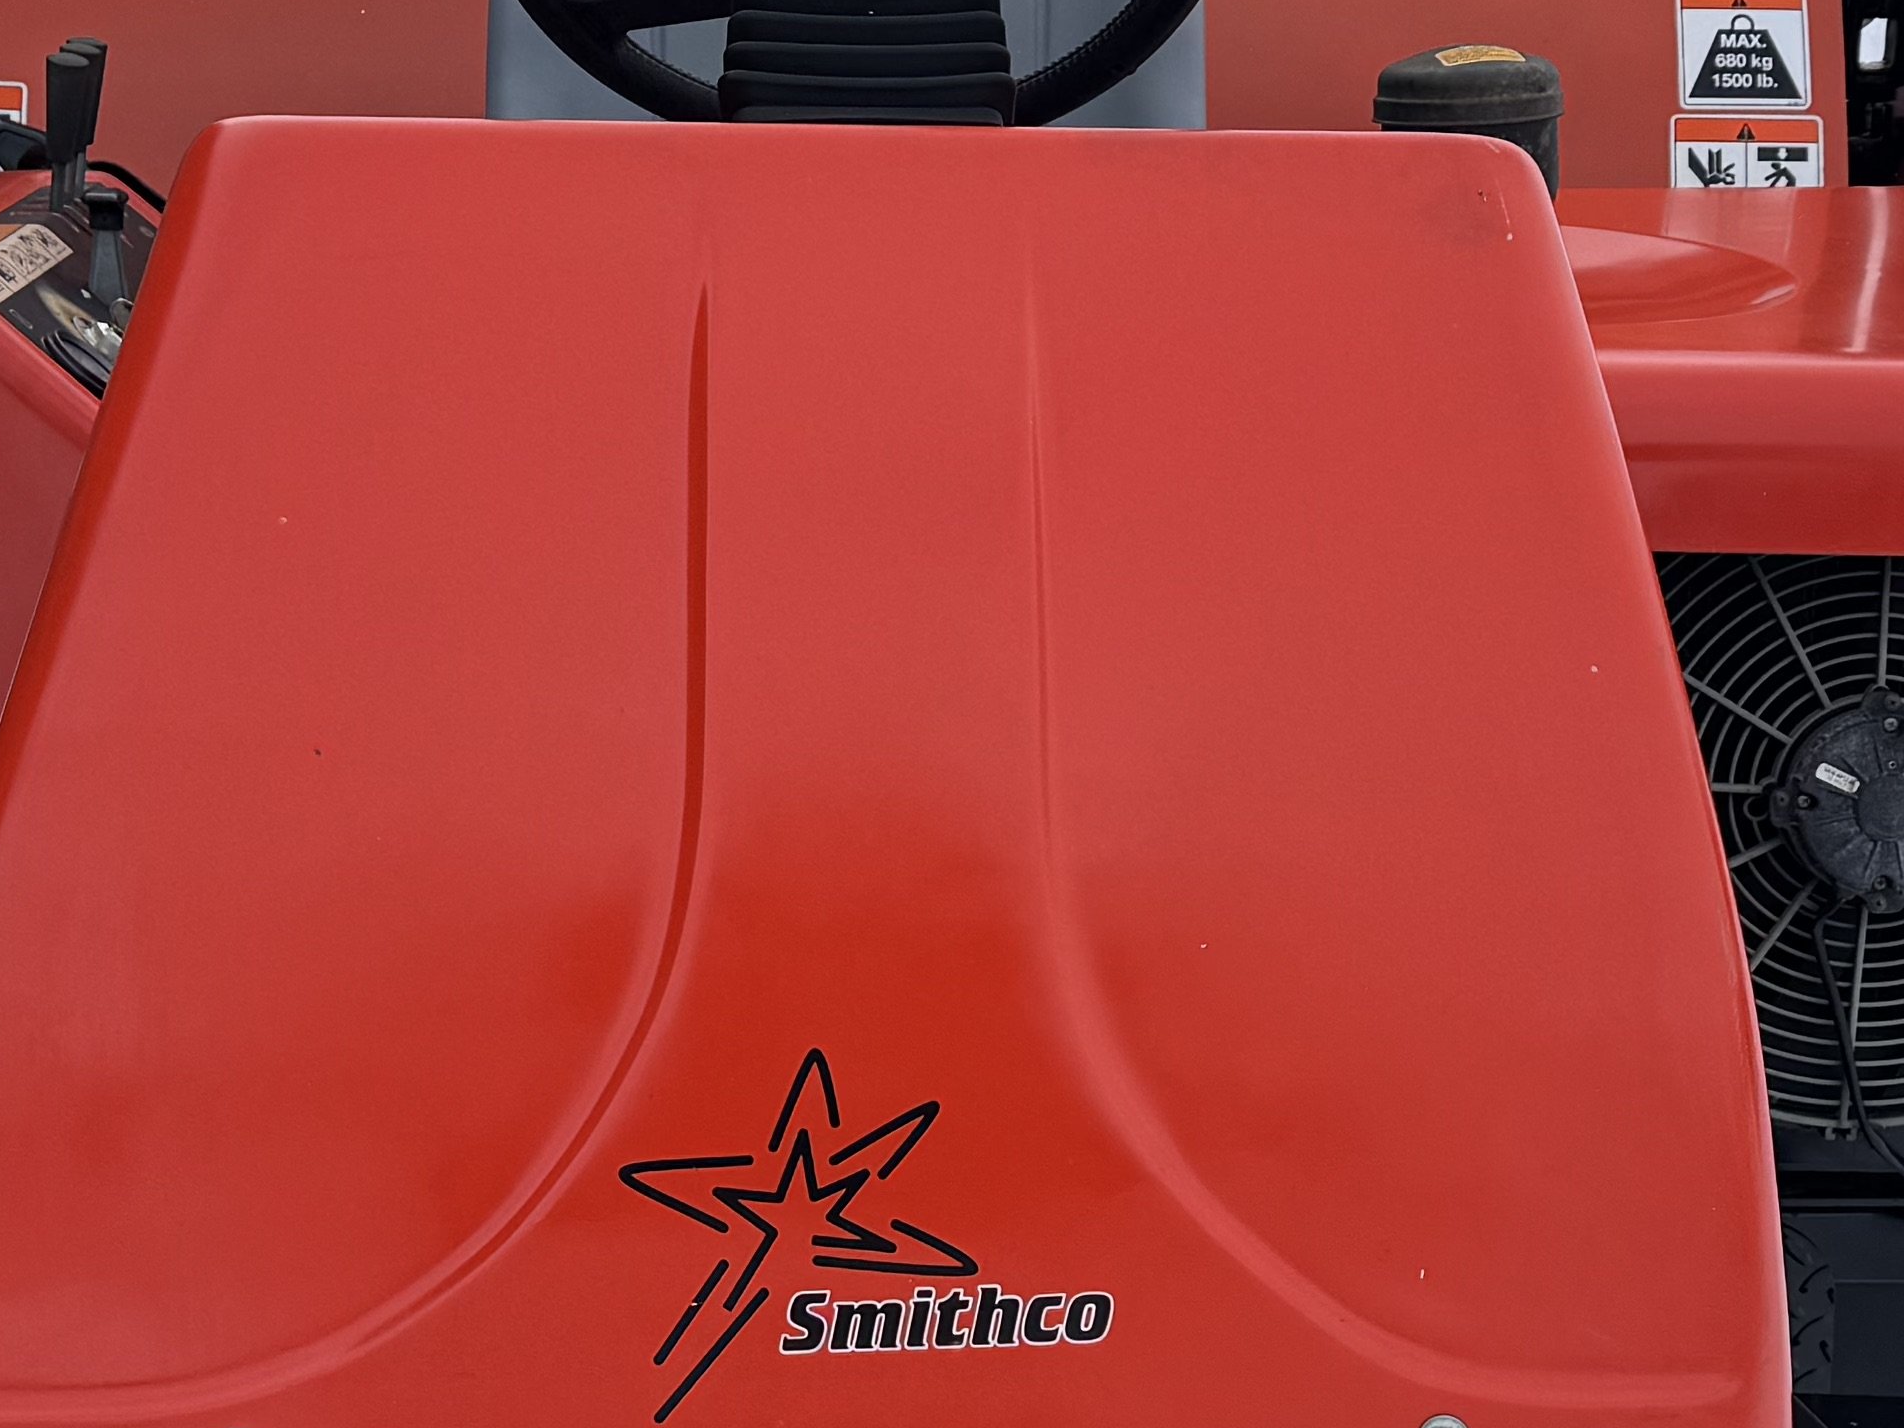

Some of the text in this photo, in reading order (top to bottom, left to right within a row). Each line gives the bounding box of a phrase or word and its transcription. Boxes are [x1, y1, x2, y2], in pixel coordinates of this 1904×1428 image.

[1719, 33, 1767, 48] MAX.
[1714, 53, 1774, 71] 680 kg
[1711, 73, 1779, 88] 1500 lb.
[780, 1285, 1114, 1355] Smithco
